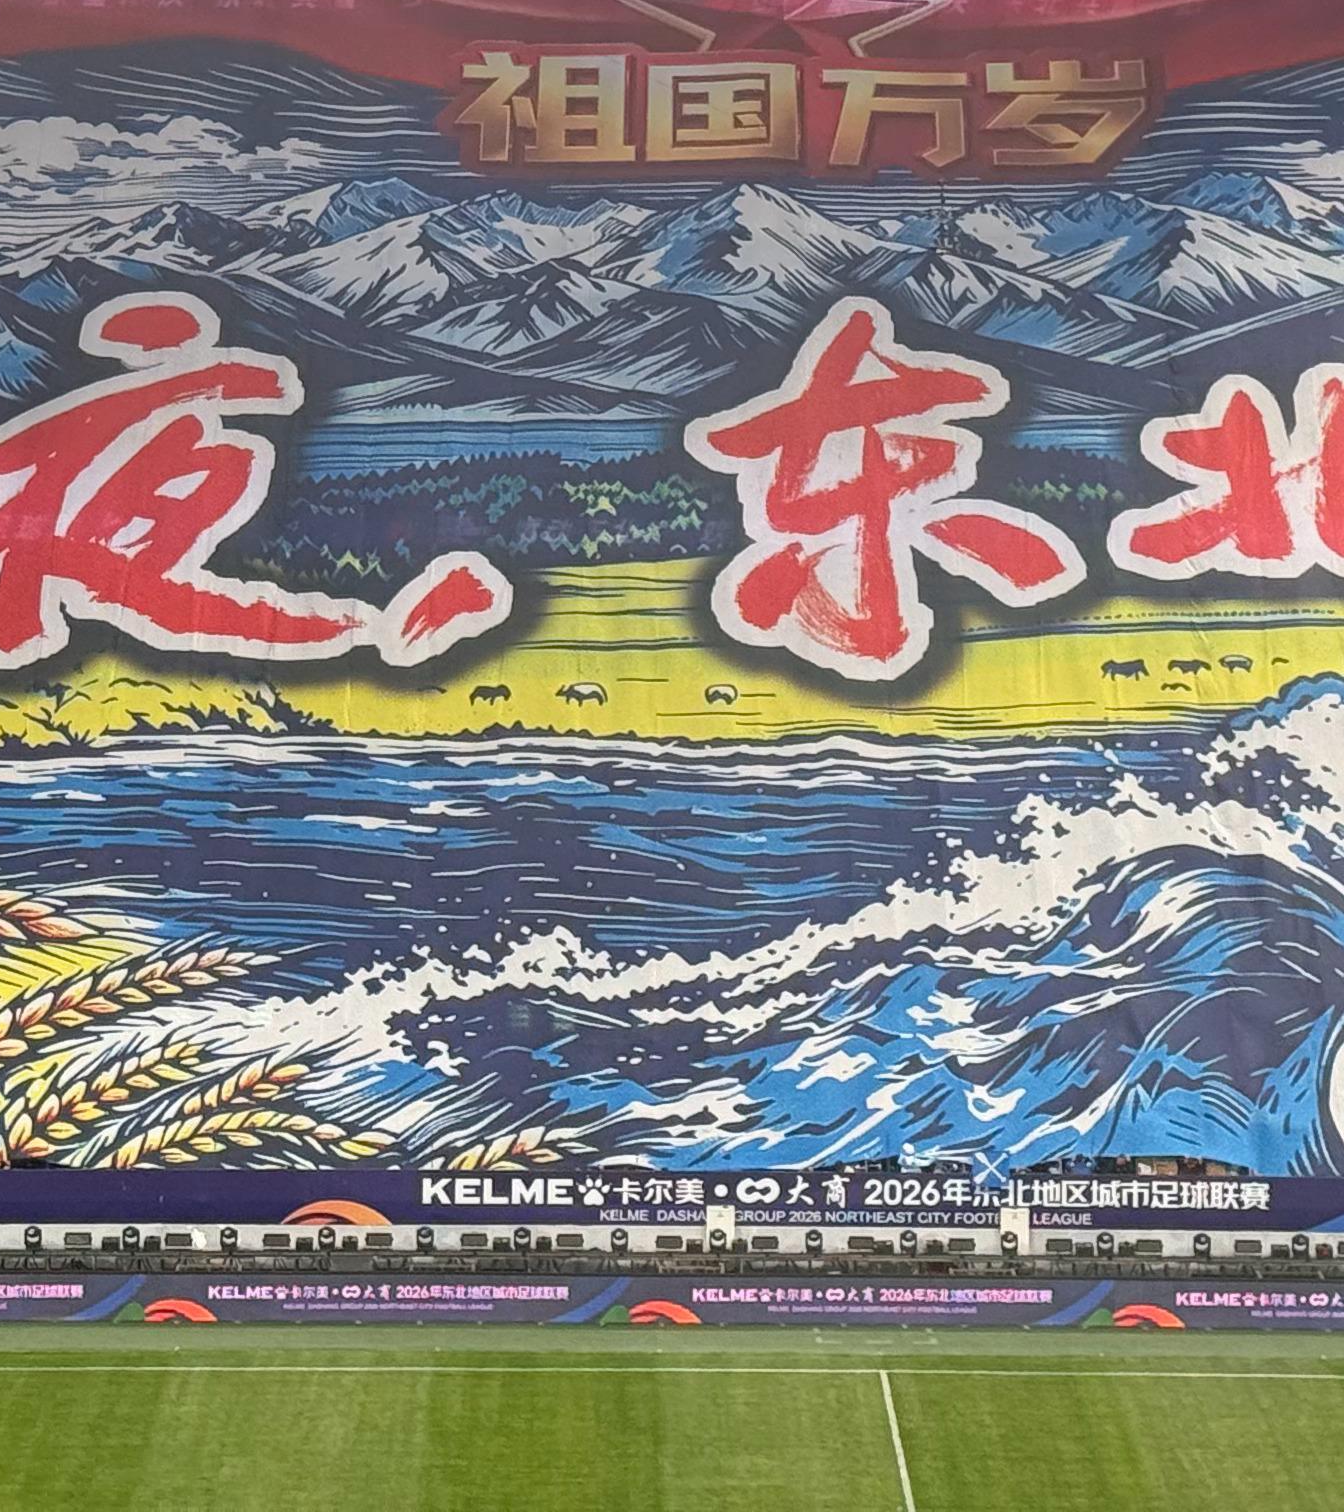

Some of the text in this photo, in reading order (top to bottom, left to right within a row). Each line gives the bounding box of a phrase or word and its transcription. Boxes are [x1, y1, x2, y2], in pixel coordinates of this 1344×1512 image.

[456, 51, 1148, 169] 祖国万岁
[421, 1178, 574, 1205] KELME
[612, 1178, 705, 1205] 卡尔美
[786, 1175, 850, 1208] 大商
[599, 1209, 1093, 1226] KELME DASHA GROUP 2026 NORTHEAST CITY FOOT LEAGUE
[208, 1286, 273, 1300] KELME
[692, 1288, 757, 1303] KELME
[1175, 1292, 1241, 1307] KELME
